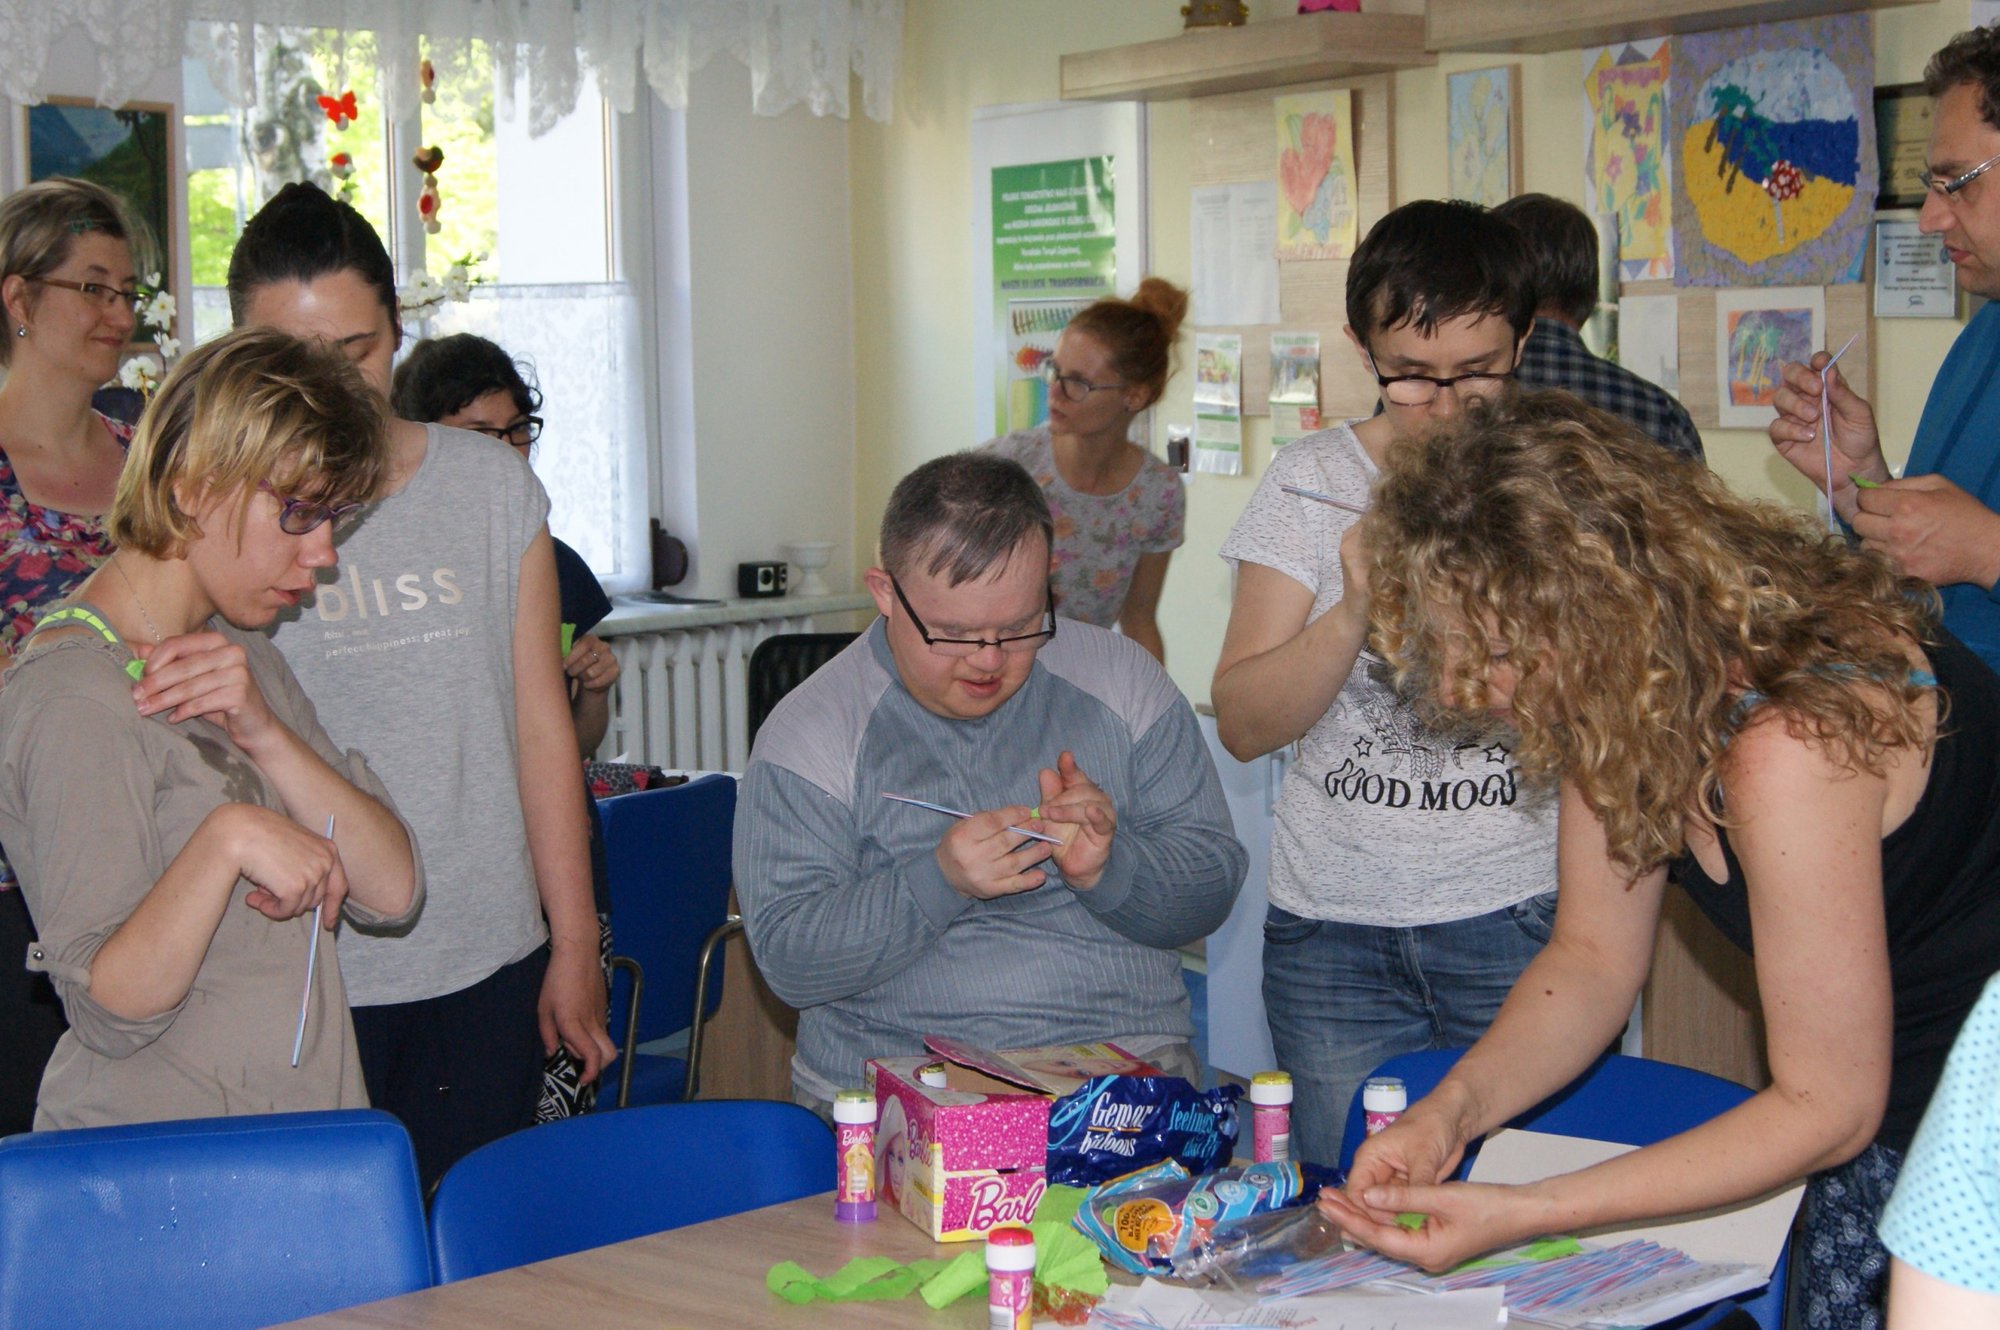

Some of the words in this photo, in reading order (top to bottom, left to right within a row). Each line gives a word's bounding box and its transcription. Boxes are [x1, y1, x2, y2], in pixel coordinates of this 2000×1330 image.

[423, 628, 452, 642] great
[1324, 758, 1411, 808] GOOD
[1091, 1091, 1155, 1128] Gemar
[1168, 1100, 1216, 1139] feelings
[842, 1129, 871, 1146] Barbie
[1119, 1212, 1130, 1231] 100
